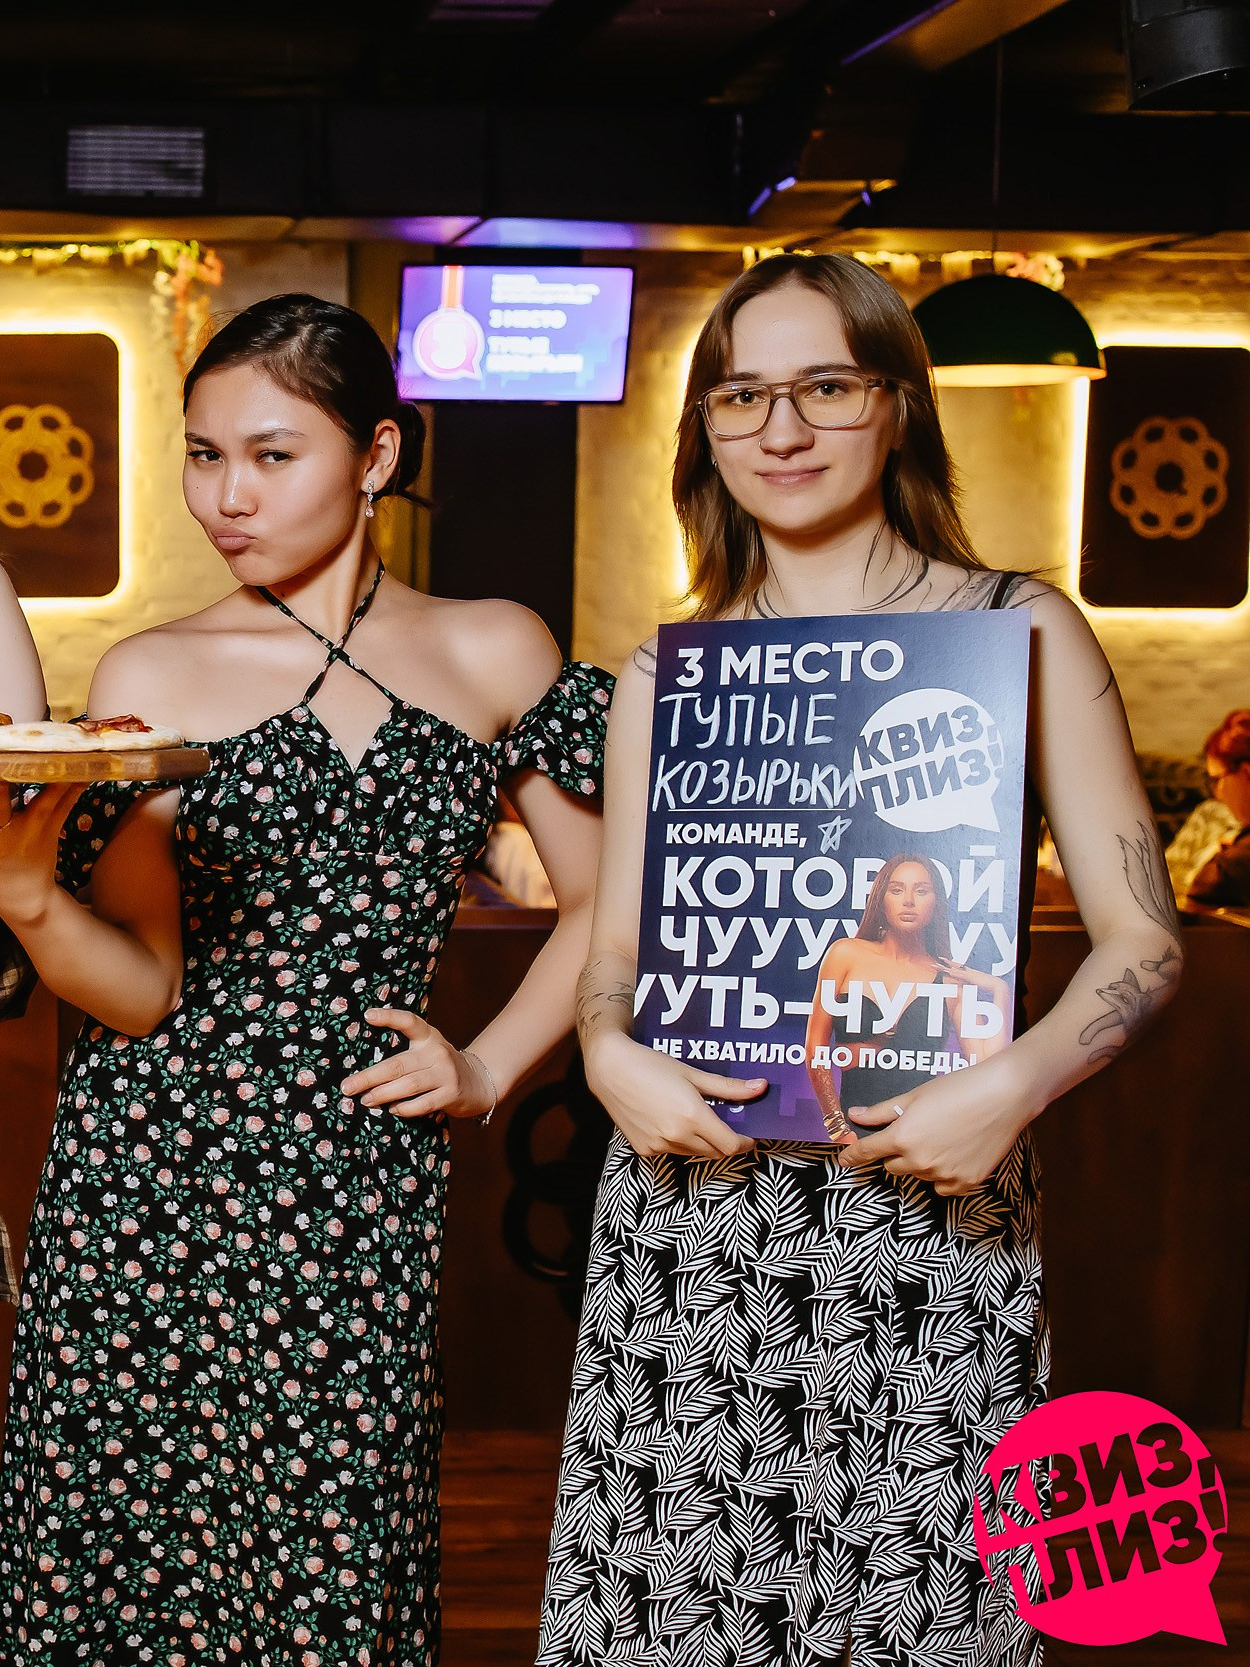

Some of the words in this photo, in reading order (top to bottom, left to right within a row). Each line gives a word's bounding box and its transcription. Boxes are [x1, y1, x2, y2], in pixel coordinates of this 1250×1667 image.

[676, 647, 704, 687] 3
[720, 640, 904, 685] МЕСТО
[659, 693, 837, 749] ТУПЫЕ
[652, 754, 858, 812] КОЗЫРЬКИ
[665, 822, 807, 848] КОМАНДЕ,
[662, 845, 1005, 913] КОТОРЙ
[652, 1038, 683, 1059] НЕ
[687, 1040, 806, 1065] ХВАТИЛО
[811, 1046, 853, 1070] ДО
